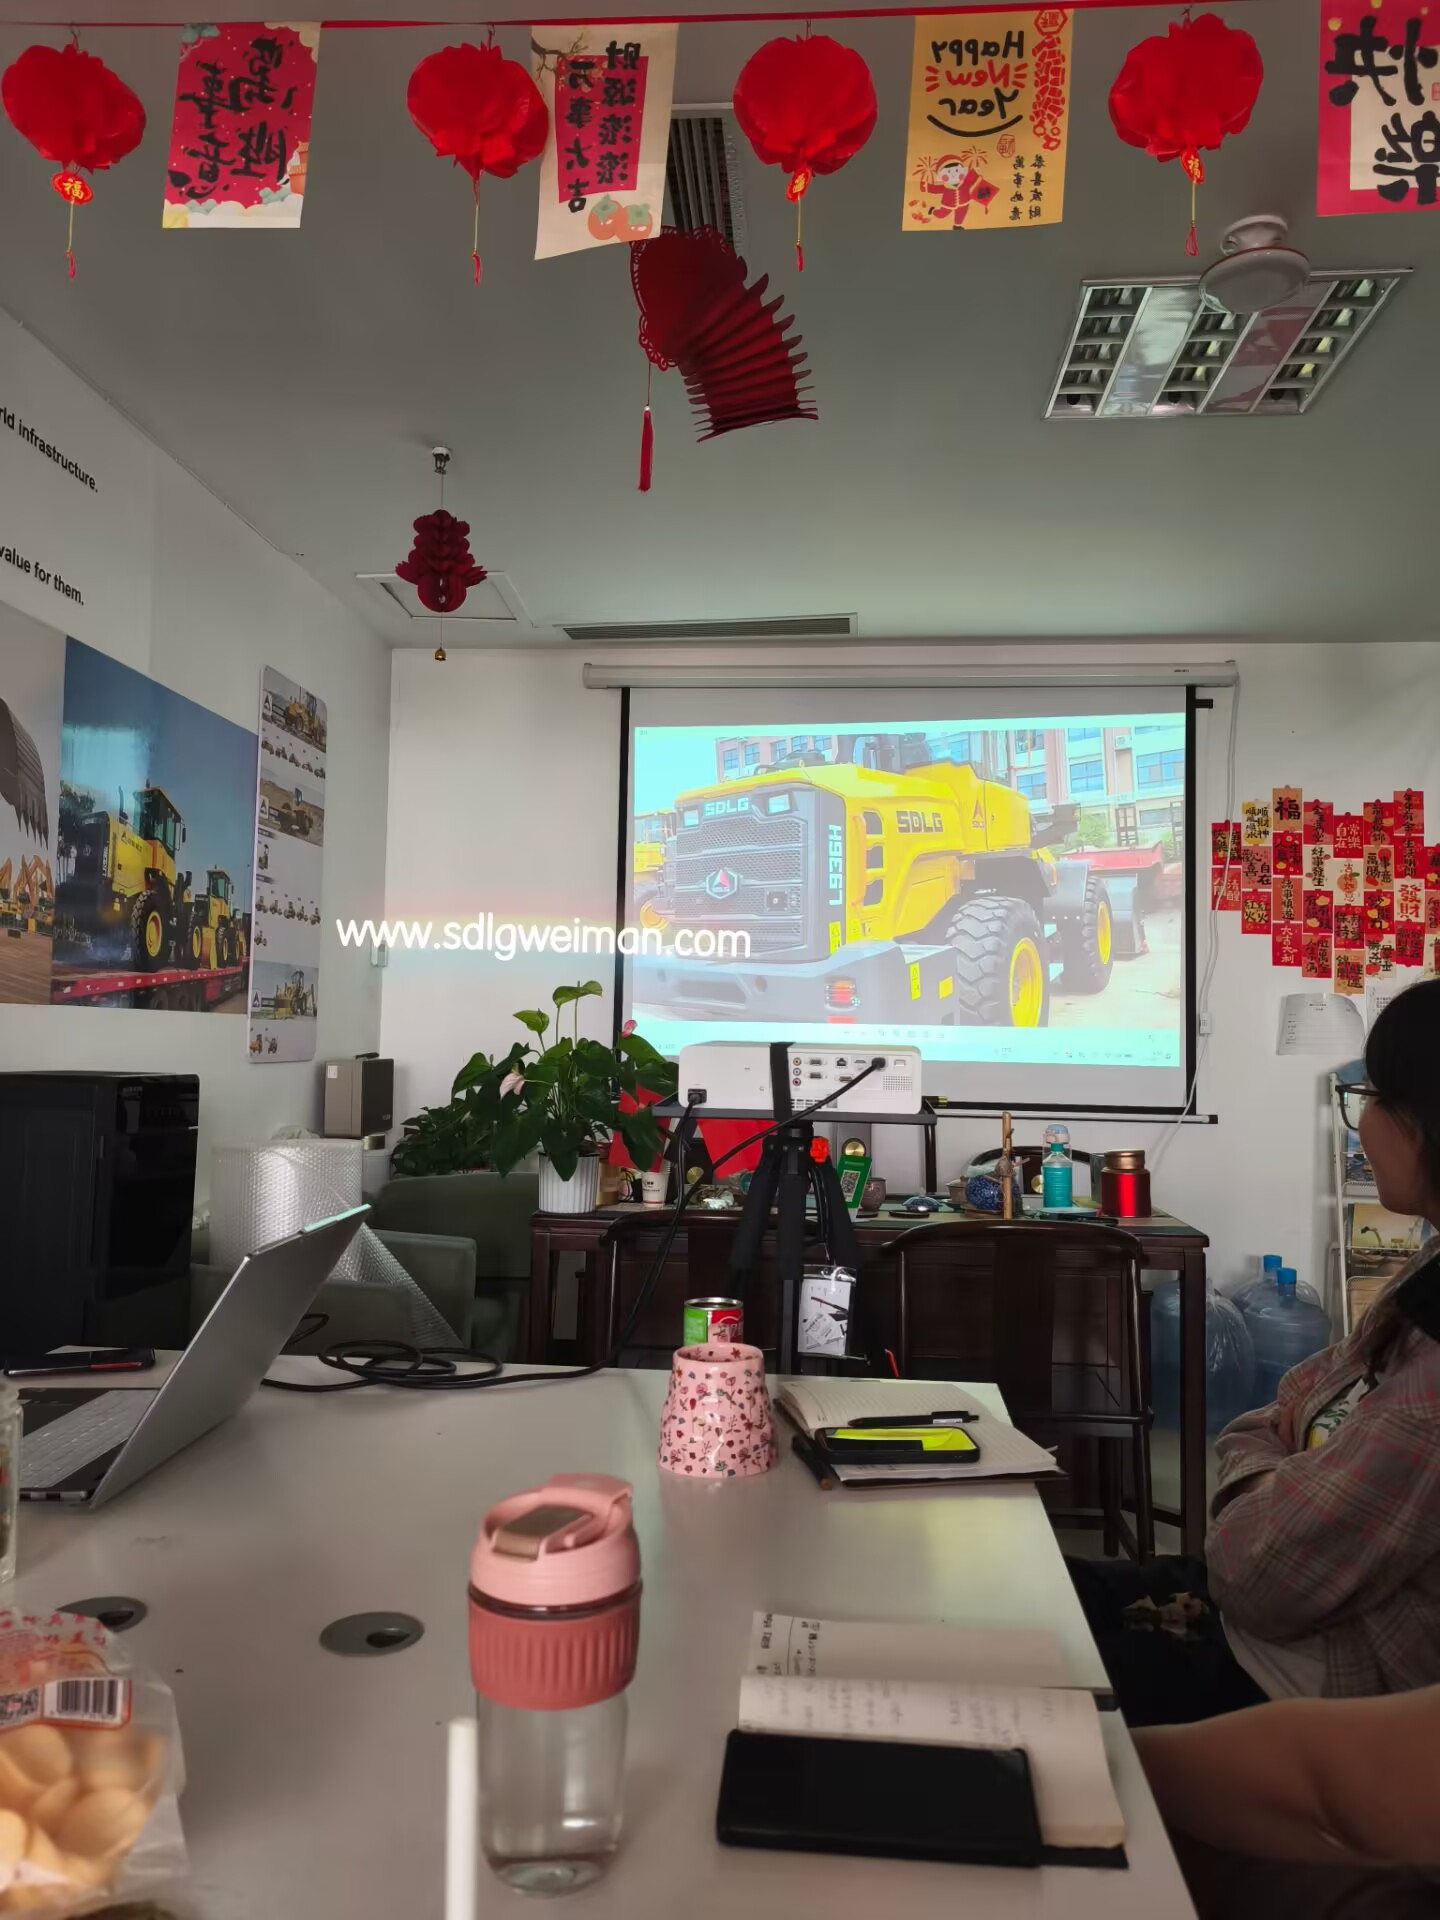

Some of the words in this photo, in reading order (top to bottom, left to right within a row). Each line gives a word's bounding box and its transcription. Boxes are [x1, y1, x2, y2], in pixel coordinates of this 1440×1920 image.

[63, 178, 84, 200] 福
[18, 418, 98, 493] infrastructure.
[34, 562, 51, 585] for
[53, 574, 84, 605] them.
[704, 797, 749, 816] SDLG
[1274, 797, 1301, 820] 福
[895, 810, 944, 833] SDLG
[828, 825, 843, 906] L936H
